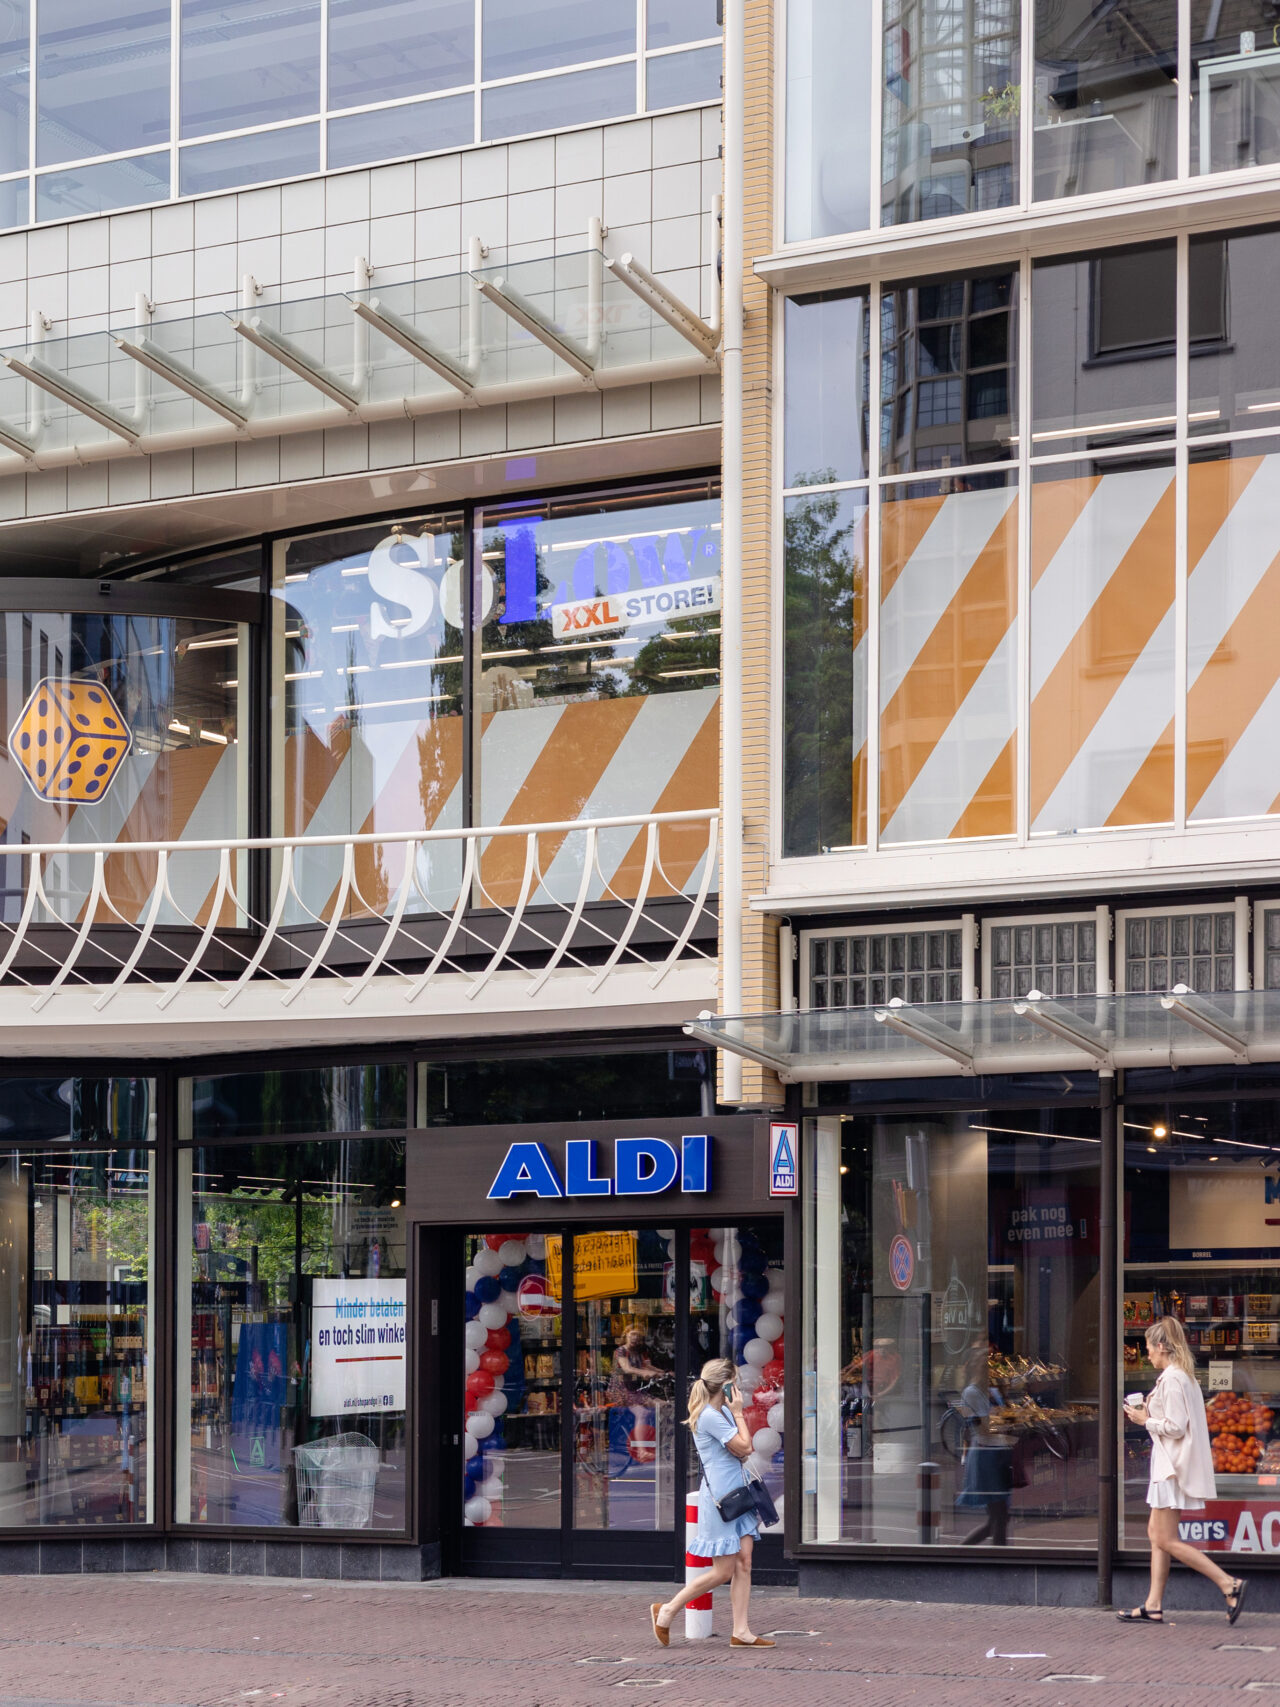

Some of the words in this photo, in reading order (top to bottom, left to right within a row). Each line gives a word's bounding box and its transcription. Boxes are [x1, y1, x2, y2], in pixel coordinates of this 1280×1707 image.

[561, 602, 619, 632] XXL
[625, 584, 714, 618] STORE!
[486, 1135, 713, 1199] ALDI
[775, 1175, 794, 1187] ALDI
[1012, 1206, 1038, 1226] pak
[1041, 1207, 1066, 1223] nog
[1007, 1228, 1040, 1241] even
[1044, 1224, 1074, 1238] mee
[335, 1298, 368, 1319] Minder
[370, 1297, 404, 1317] betalen
[319, 1329, 331, 1346] en
[332, 1325, 353, 1346] toch
[355, 1323, 376, 1344] slim
[1212, 1378, 1229, 1386] 2.49
[1178, 1521, 1225, 1540] vers
